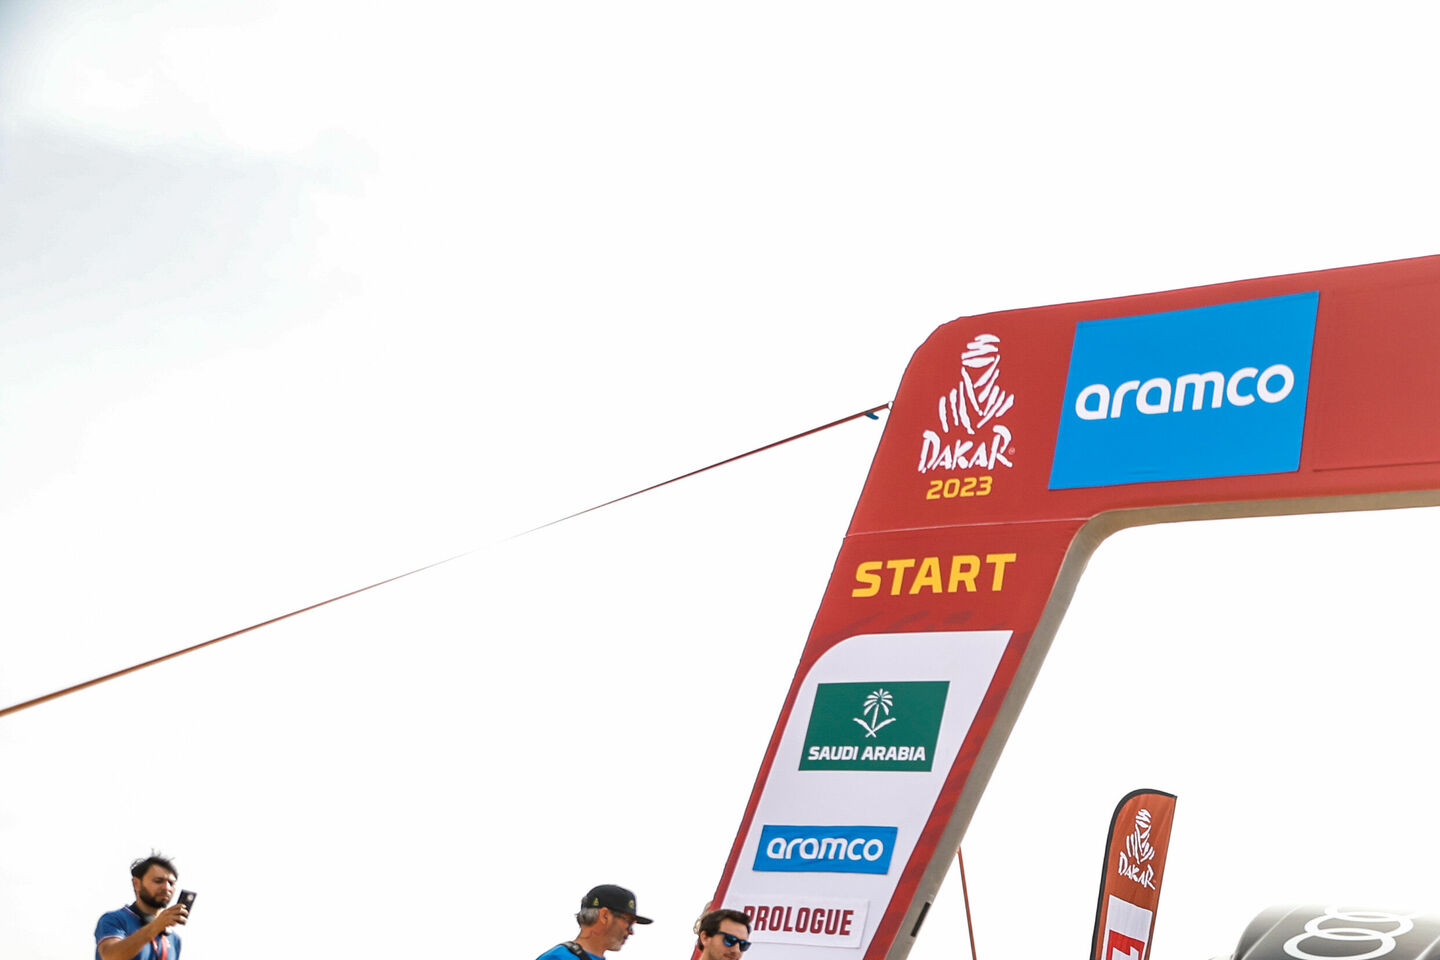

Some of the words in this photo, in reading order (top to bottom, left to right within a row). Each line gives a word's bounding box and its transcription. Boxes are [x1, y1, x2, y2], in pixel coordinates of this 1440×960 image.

[1075, 363, 1295, 421] aramco
[918, 425, 1013, 473] DAKAR
[926, 475, 993, 500] 2023
[852, 552, 1017, 598] START
[807, 746, 859, 761] SAUDI
[861, 746, 926, 761] ARABIA
[766, 836, 884, 862] aramco
[1118, 851, 1156, 890] DAKAR
[743, 905, 854, 936] PROLOGUE
